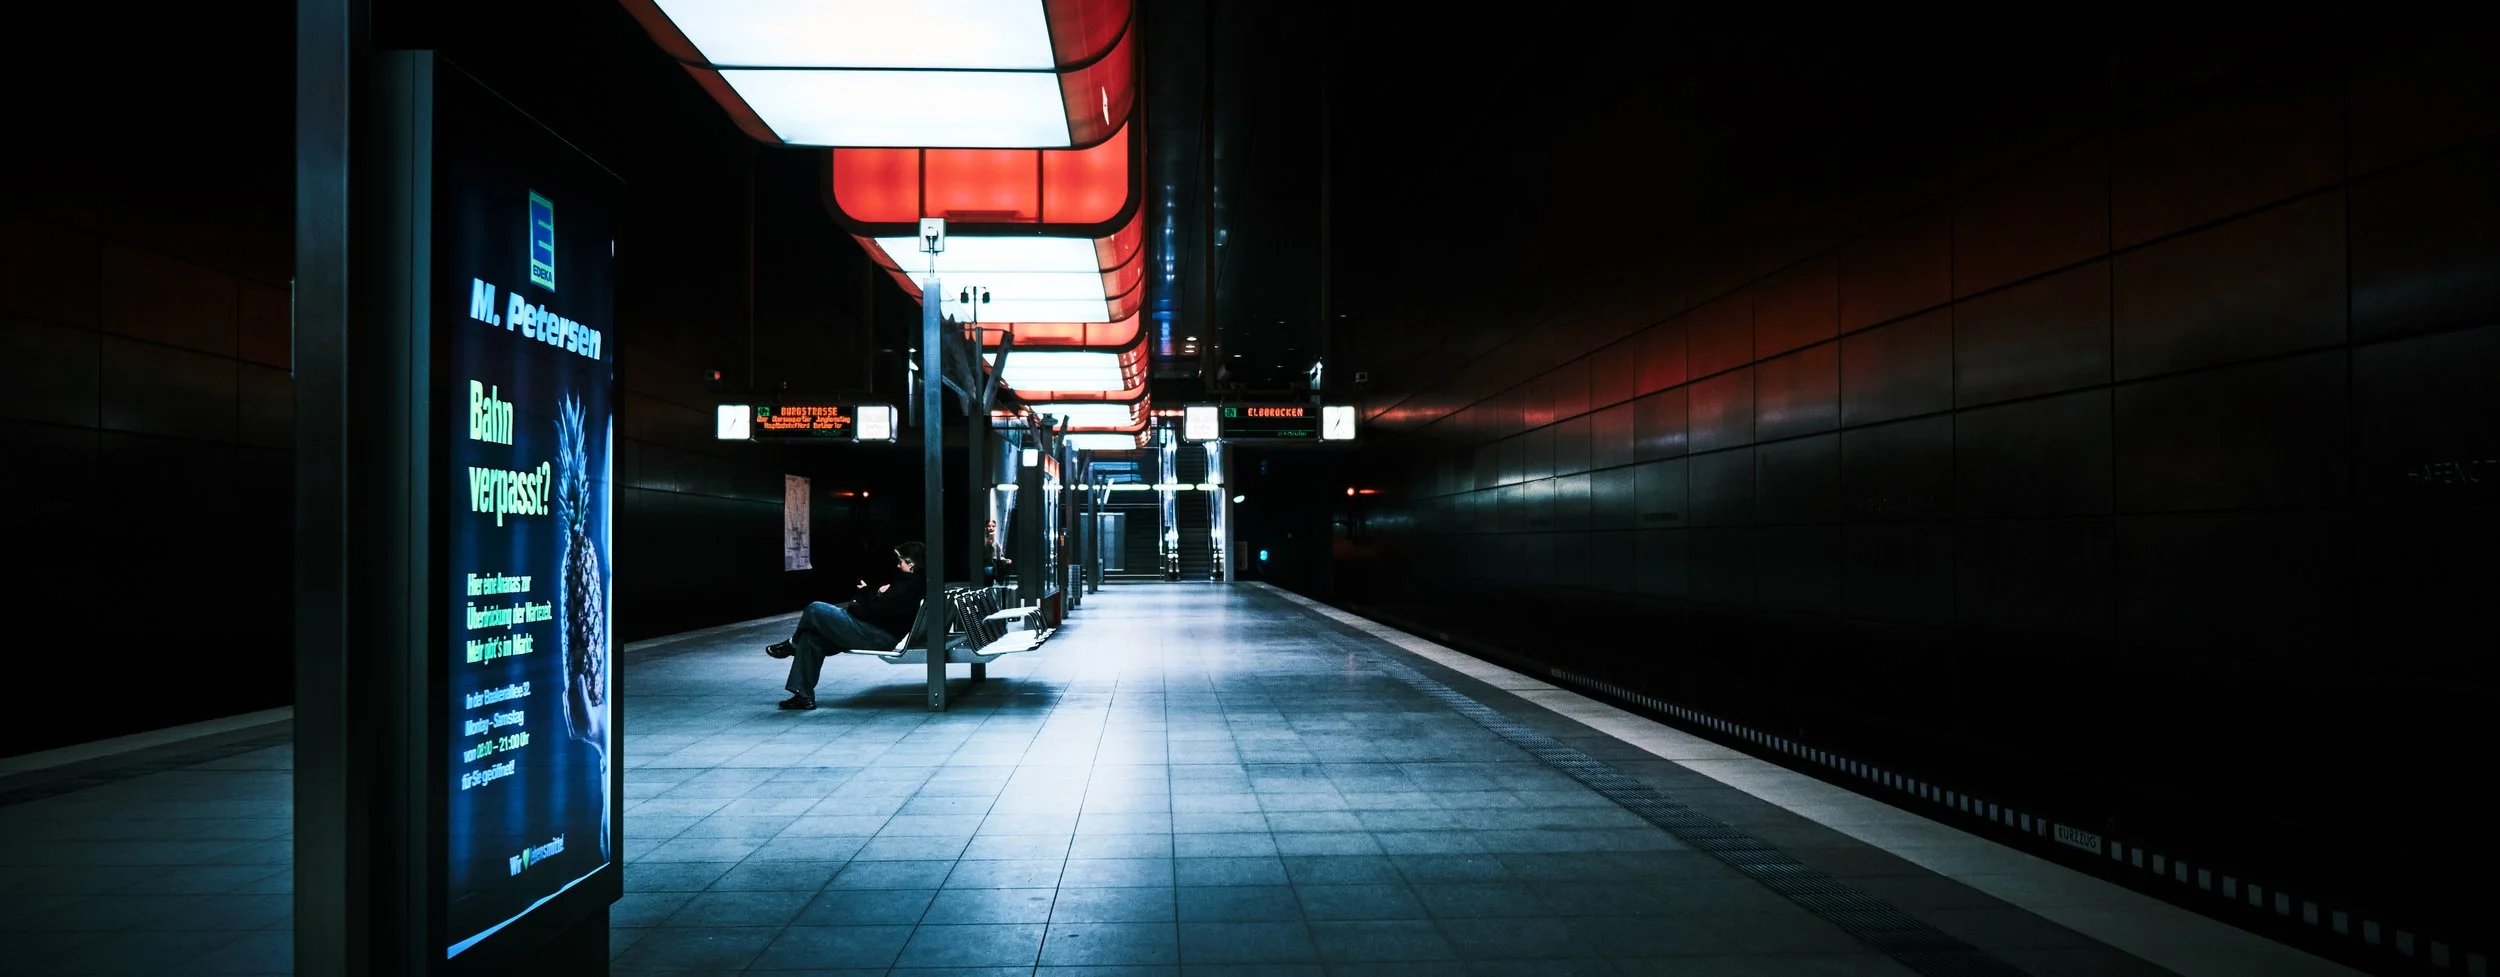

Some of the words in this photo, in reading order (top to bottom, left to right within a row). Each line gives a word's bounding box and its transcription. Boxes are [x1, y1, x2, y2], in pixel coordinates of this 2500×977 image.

[533, 264, 552, 283] EDEKA
[470, 277, 500, 327] M.
[505, 291, 601, 360] Petersen
[469, 379, 513, 445] Bahn
[469, 461, 550, 527] verpasst?
[467, 573, 483, 596] Hier
[483, 573, 497, 595] eine
[497, 572, 520, 593] Ananas
[513, 603, 525, 624] der
[467, 640, 484, 663] Mehr
[503, 636, 512, 657] im
[493, 710, 524, 728] Samstag
[464, 749, 476, 763] von
[499, 734, 520, 752] 21:00
[520, 731, 530, 747] Uhr
[2058, 826, 2097, 848] KURZZUG
[510, 855, 522, 876] Wir
